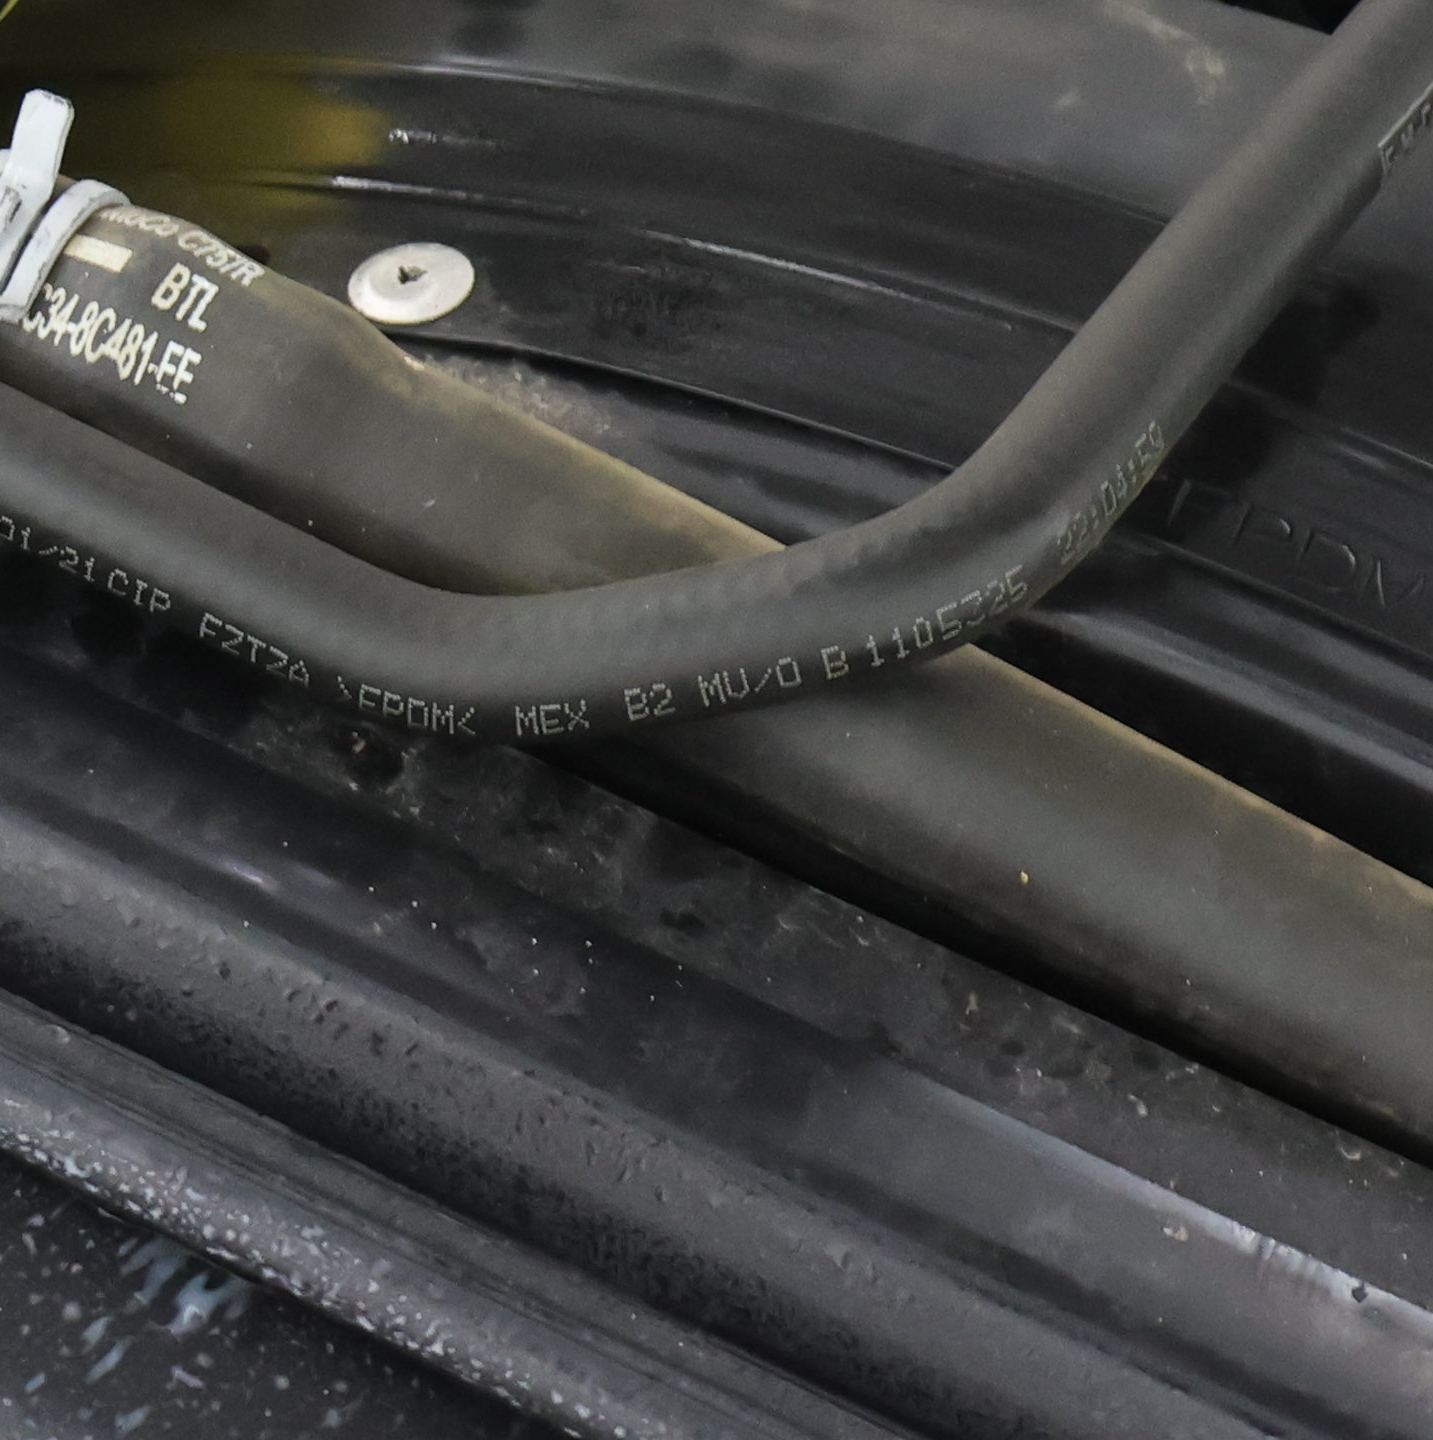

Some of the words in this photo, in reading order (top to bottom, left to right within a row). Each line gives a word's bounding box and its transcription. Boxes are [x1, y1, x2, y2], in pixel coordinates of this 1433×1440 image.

[151, 262, 219, 333] BTL
[515, 698, 591, 737] MEX
[623, 682, 676, 721] B2
